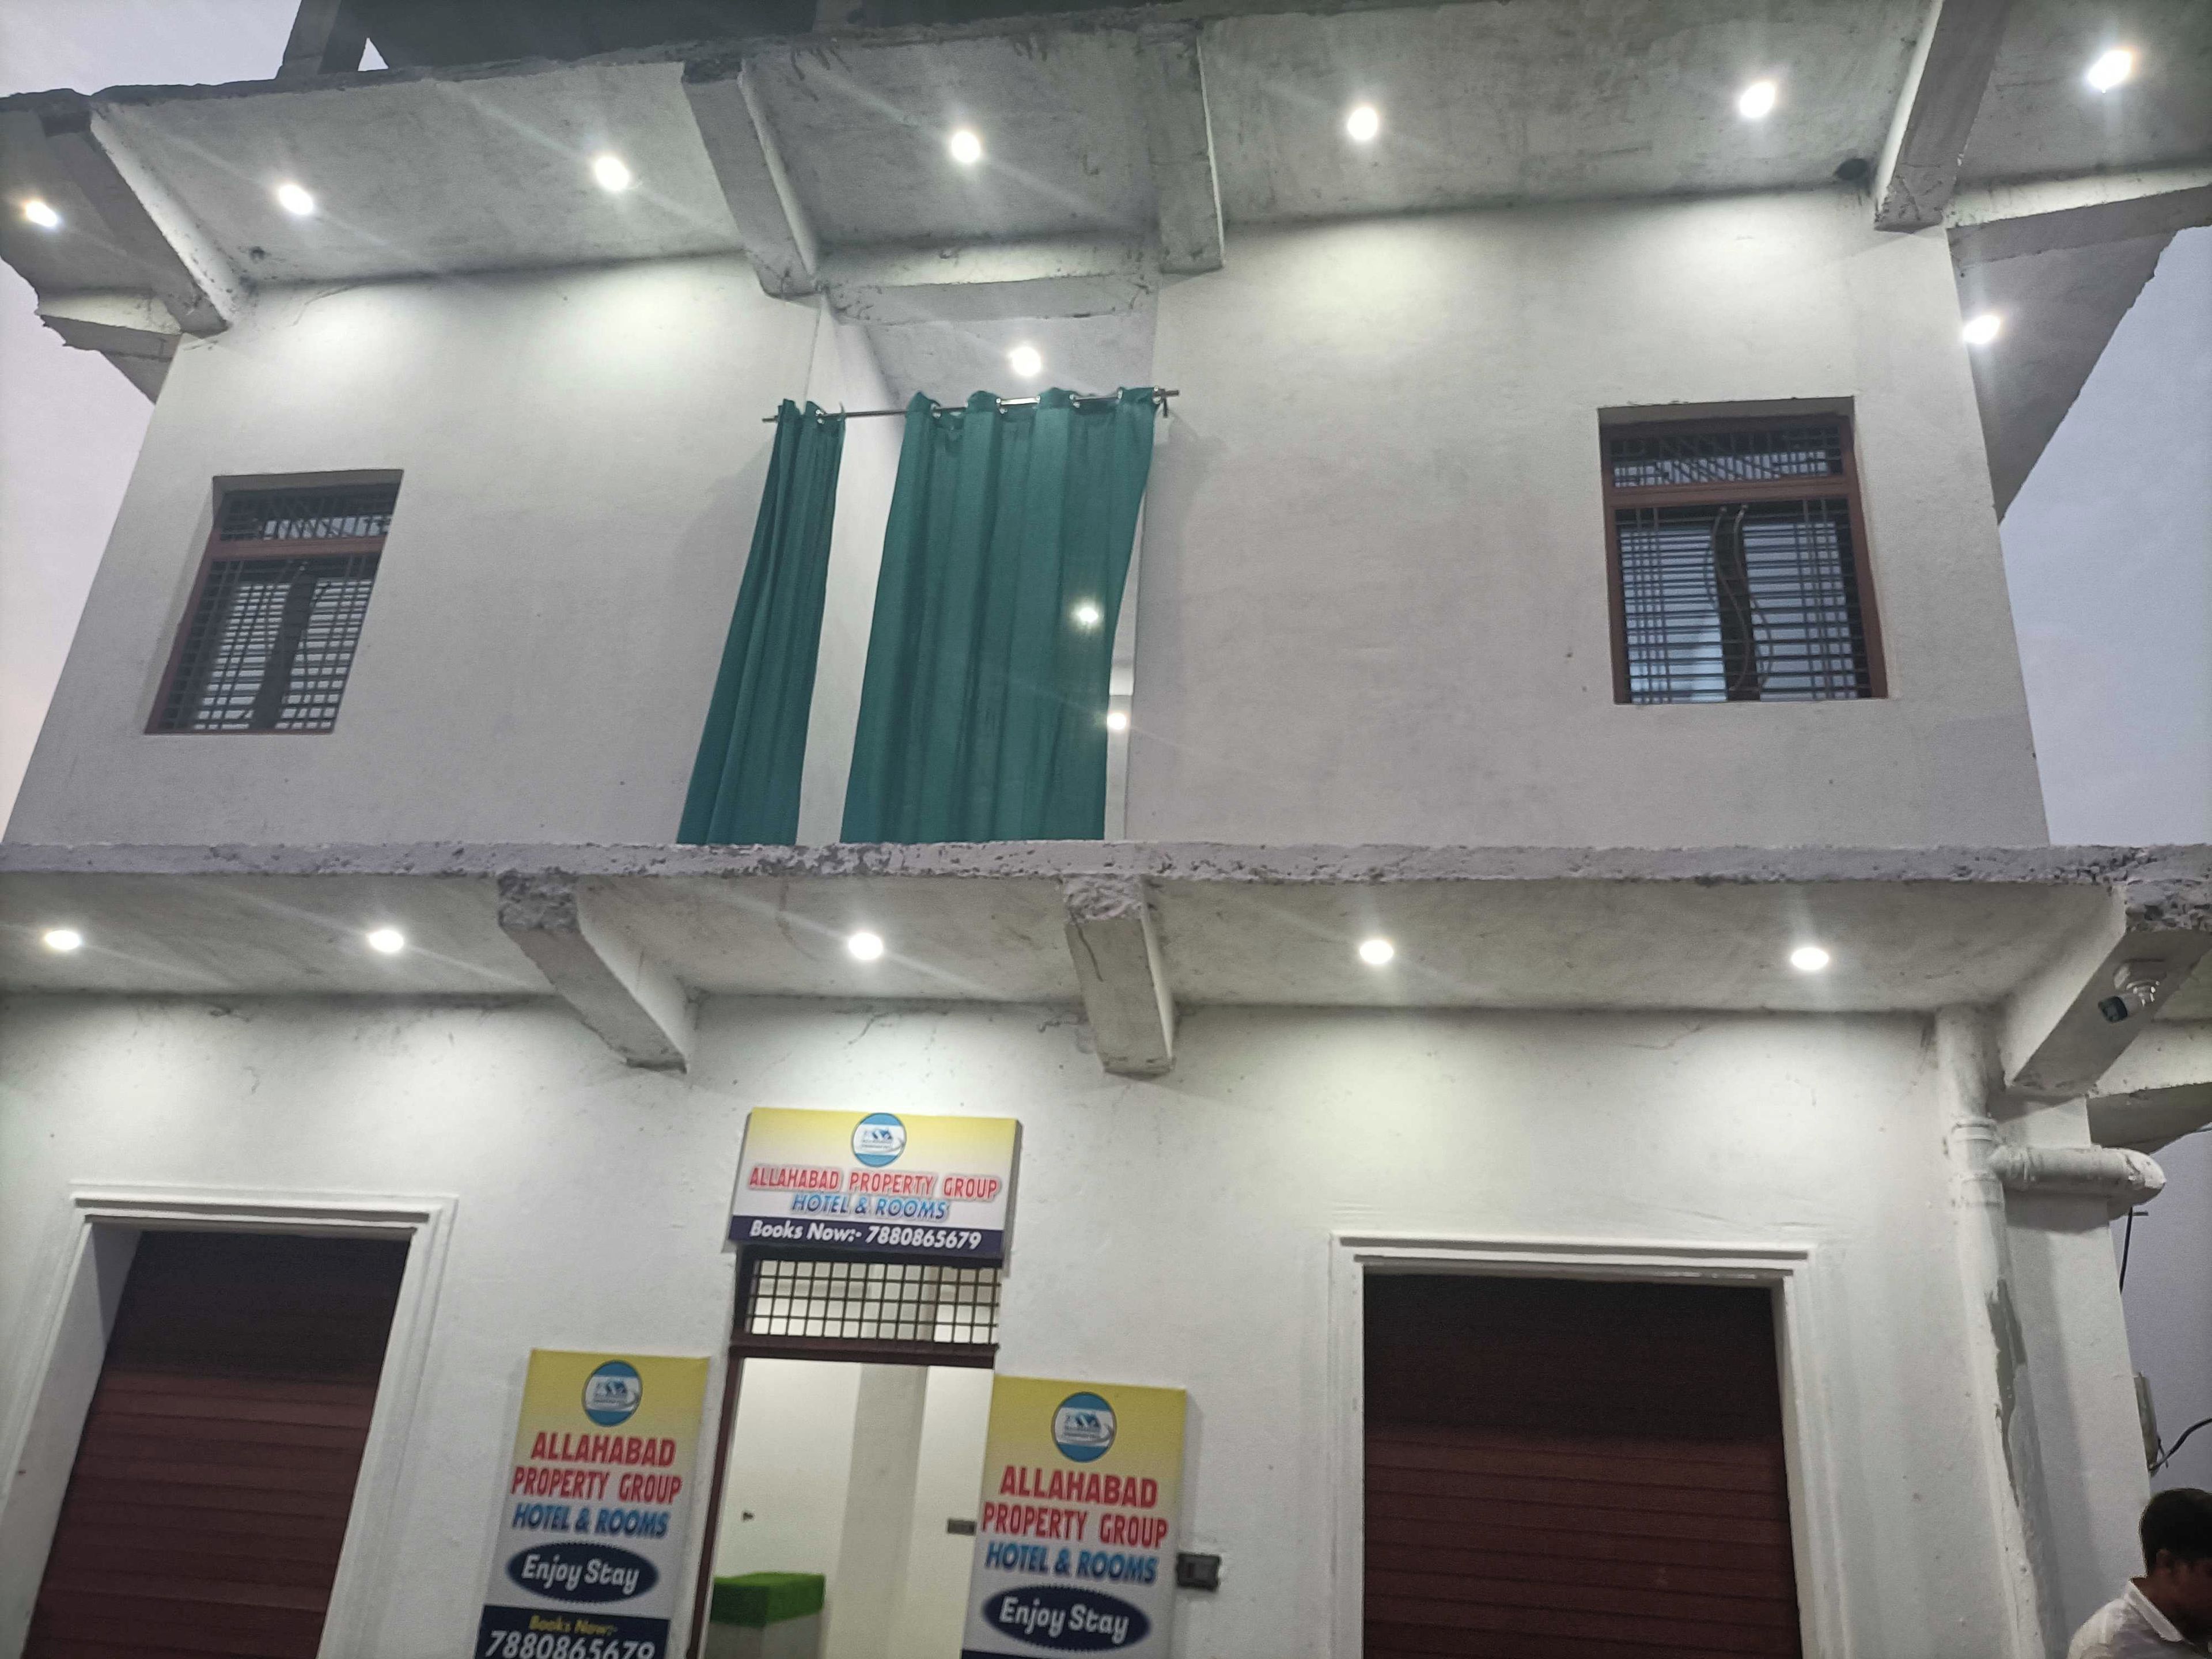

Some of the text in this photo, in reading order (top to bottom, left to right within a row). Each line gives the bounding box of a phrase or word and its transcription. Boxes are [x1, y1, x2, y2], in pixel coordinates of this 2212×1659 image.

[749, 1167, 1000, 1199] ALLAHABAD PROPERTY GROUP
[792, 1193, 948, 1219] HOTEL & ROOMS
[749, 1219, 803, 1240] Books
[865, 1226, 982, 1249] 7880865679
[531, 1432, 677, 1468] ALLAHABAD
[510, 1466, 683, 1505] PROPERTY GROUP
[1000, 1465, 1158, 1509] ALLAHABAD
[513, 1503, 671, 1539] HOTEL & ROOMS
[982, 1502, 1168, 1548] PROPERTY GROUP
[521, 1554, 640, 1596] Enjoy Stay
[985, 1540, 1158, 1585] HOTEL & ROOMS
[999, 1595, 1130, 1645] Enjoy Stay
[485, 1630, 656, 1659] 7880865679
